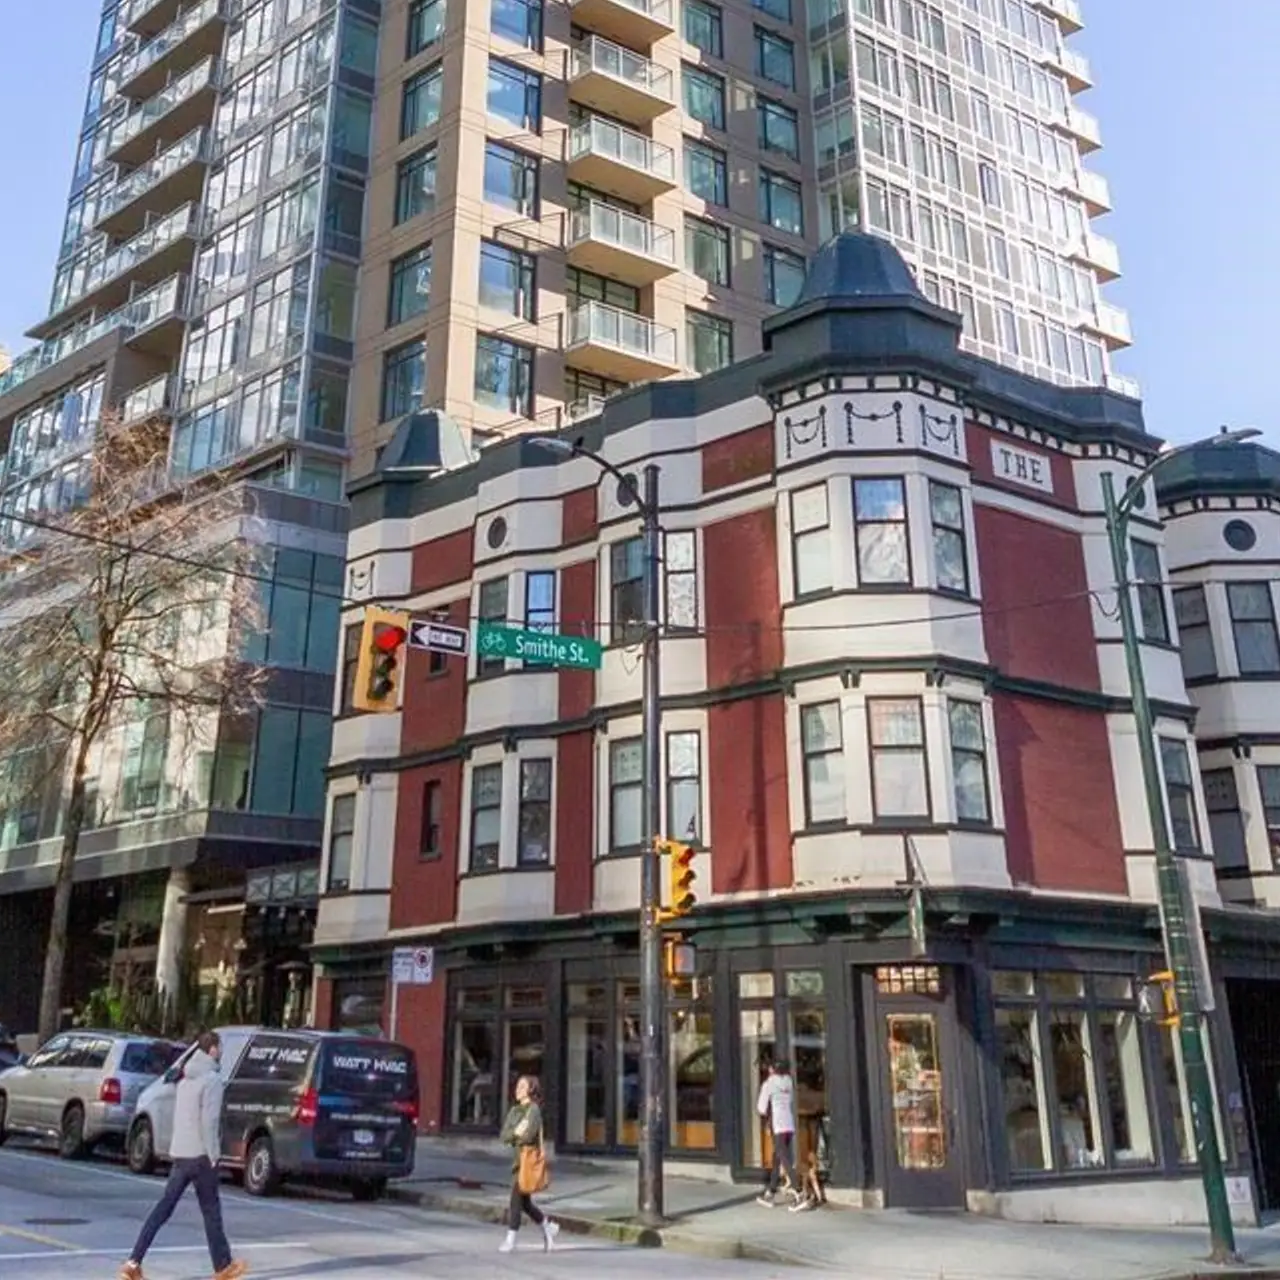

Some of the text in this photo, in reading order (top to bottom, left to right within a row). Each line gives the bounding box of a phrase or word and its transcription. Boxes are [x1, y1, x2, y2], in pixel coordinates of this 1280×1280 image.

[999, 447, 1043, 483] THE
[515, 634, 590, 663] Smithe St.
[333, 1056, 407, 1073] WATT HVAC
